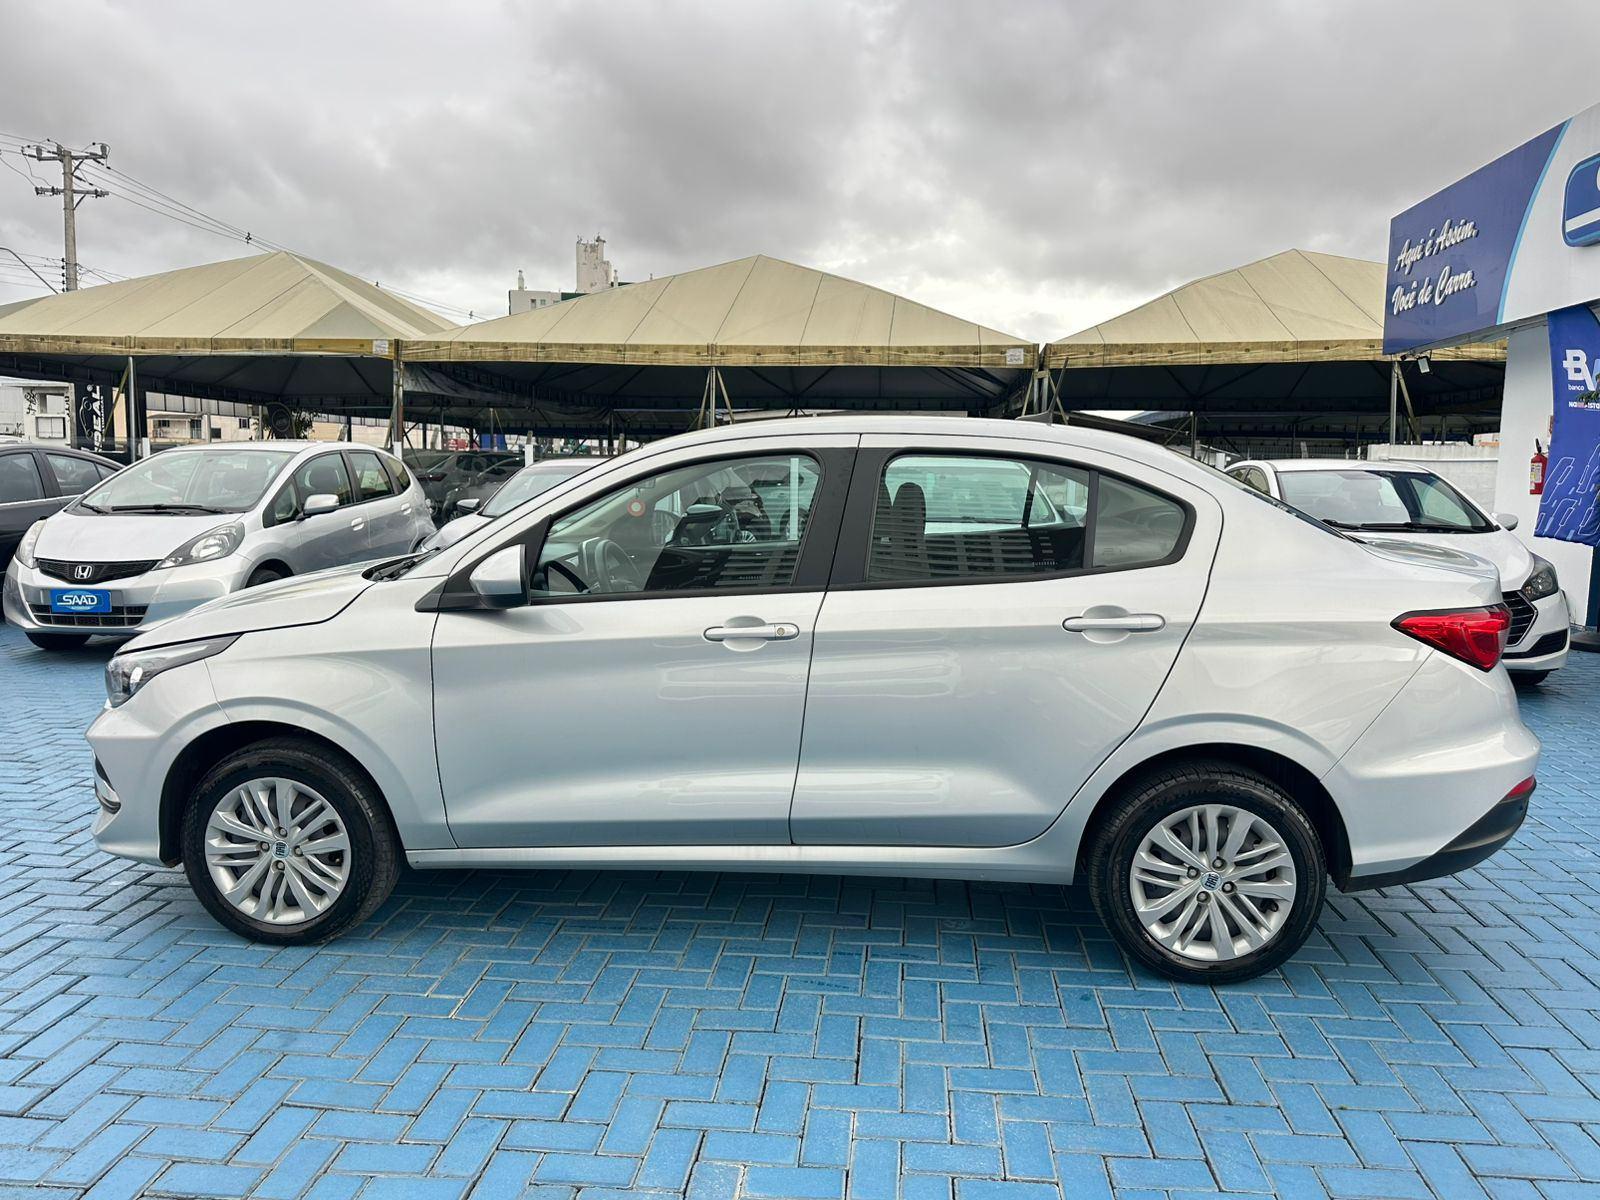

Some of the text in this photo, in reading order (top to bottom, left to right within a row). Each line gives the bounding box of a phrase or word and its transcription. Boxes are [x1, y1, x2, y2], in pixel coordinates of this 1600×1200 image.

[1395, 239, 1424, 275] Aqui
[1425, 228, 1436, 257] é
[1392, 280, 1417, 315] Você
[1418, 277, 1433, 305] de
[57, 595, 97, 605] SAAD
